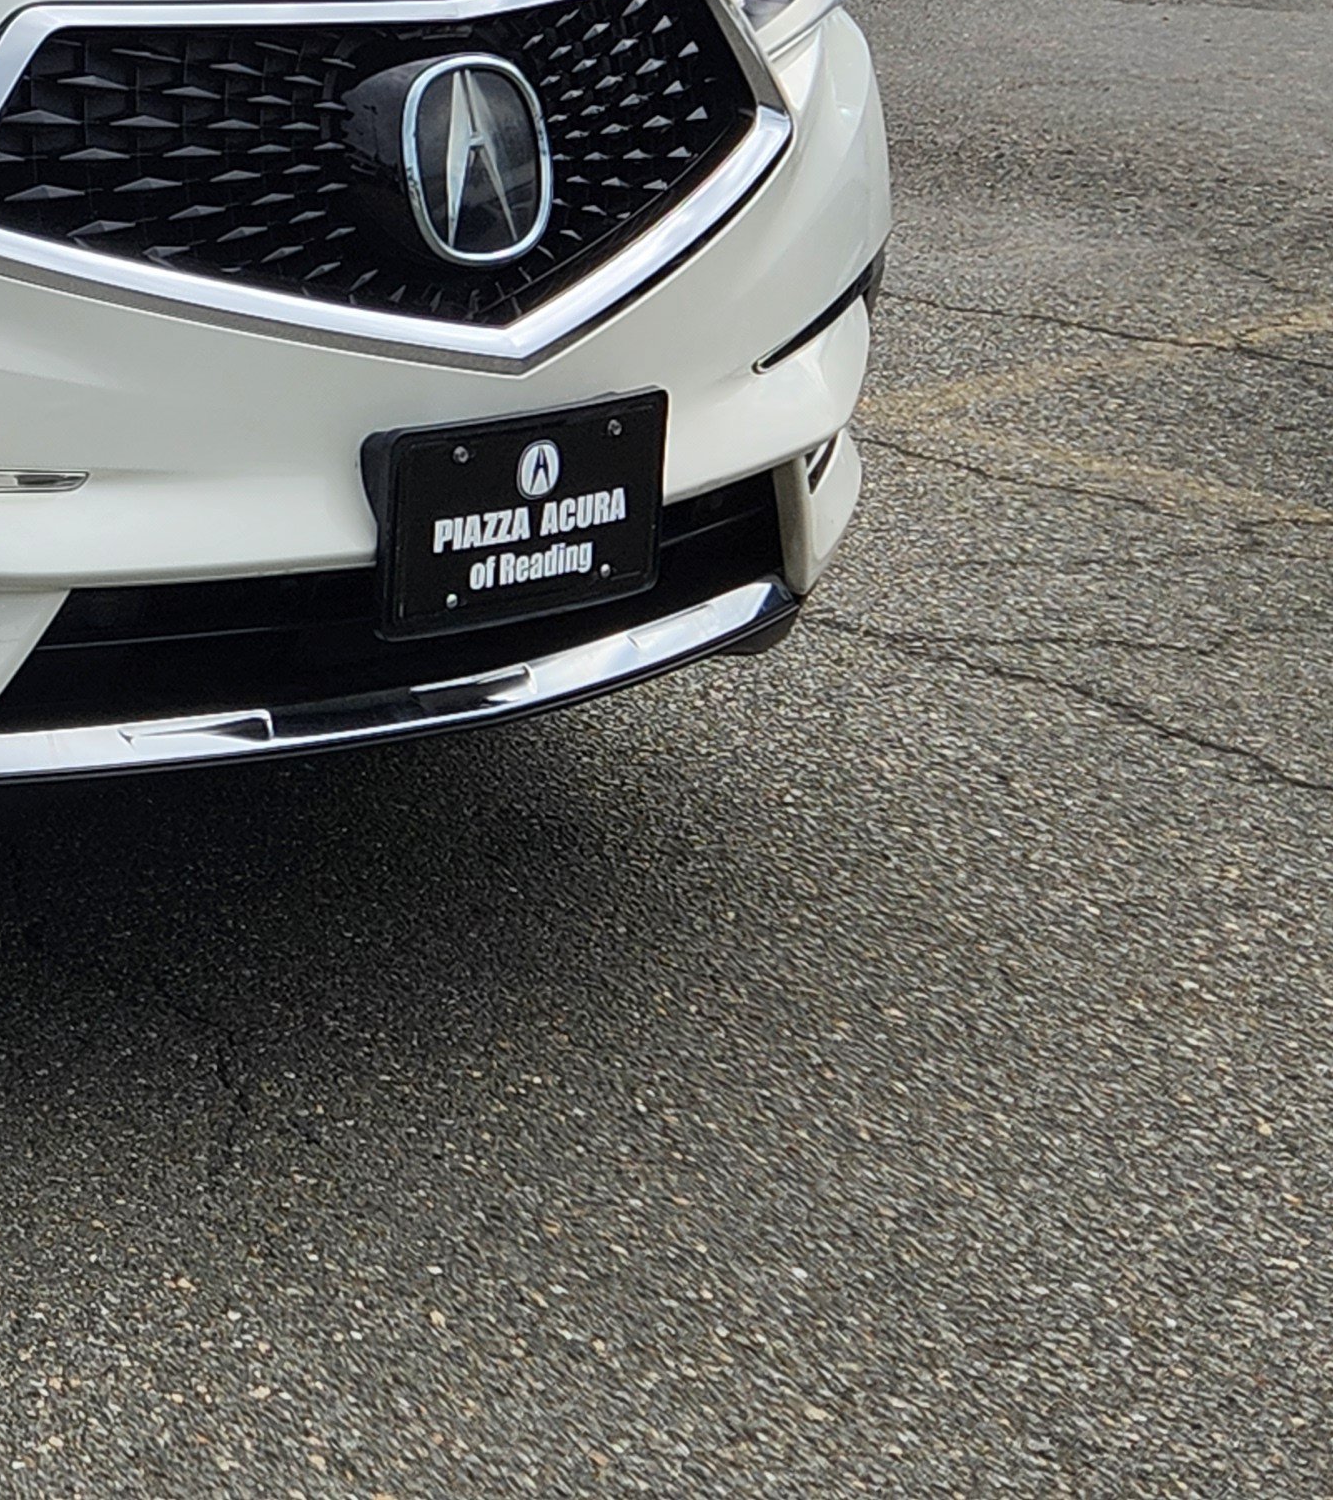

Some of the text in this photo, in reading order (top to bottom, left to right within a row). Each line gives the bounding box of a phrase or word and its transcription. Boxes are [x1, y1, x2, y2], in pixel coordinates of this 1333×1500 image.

[433, 487, 627, 554] PIAZZA ACURA
[469, 542, 594, 591] of Reading
